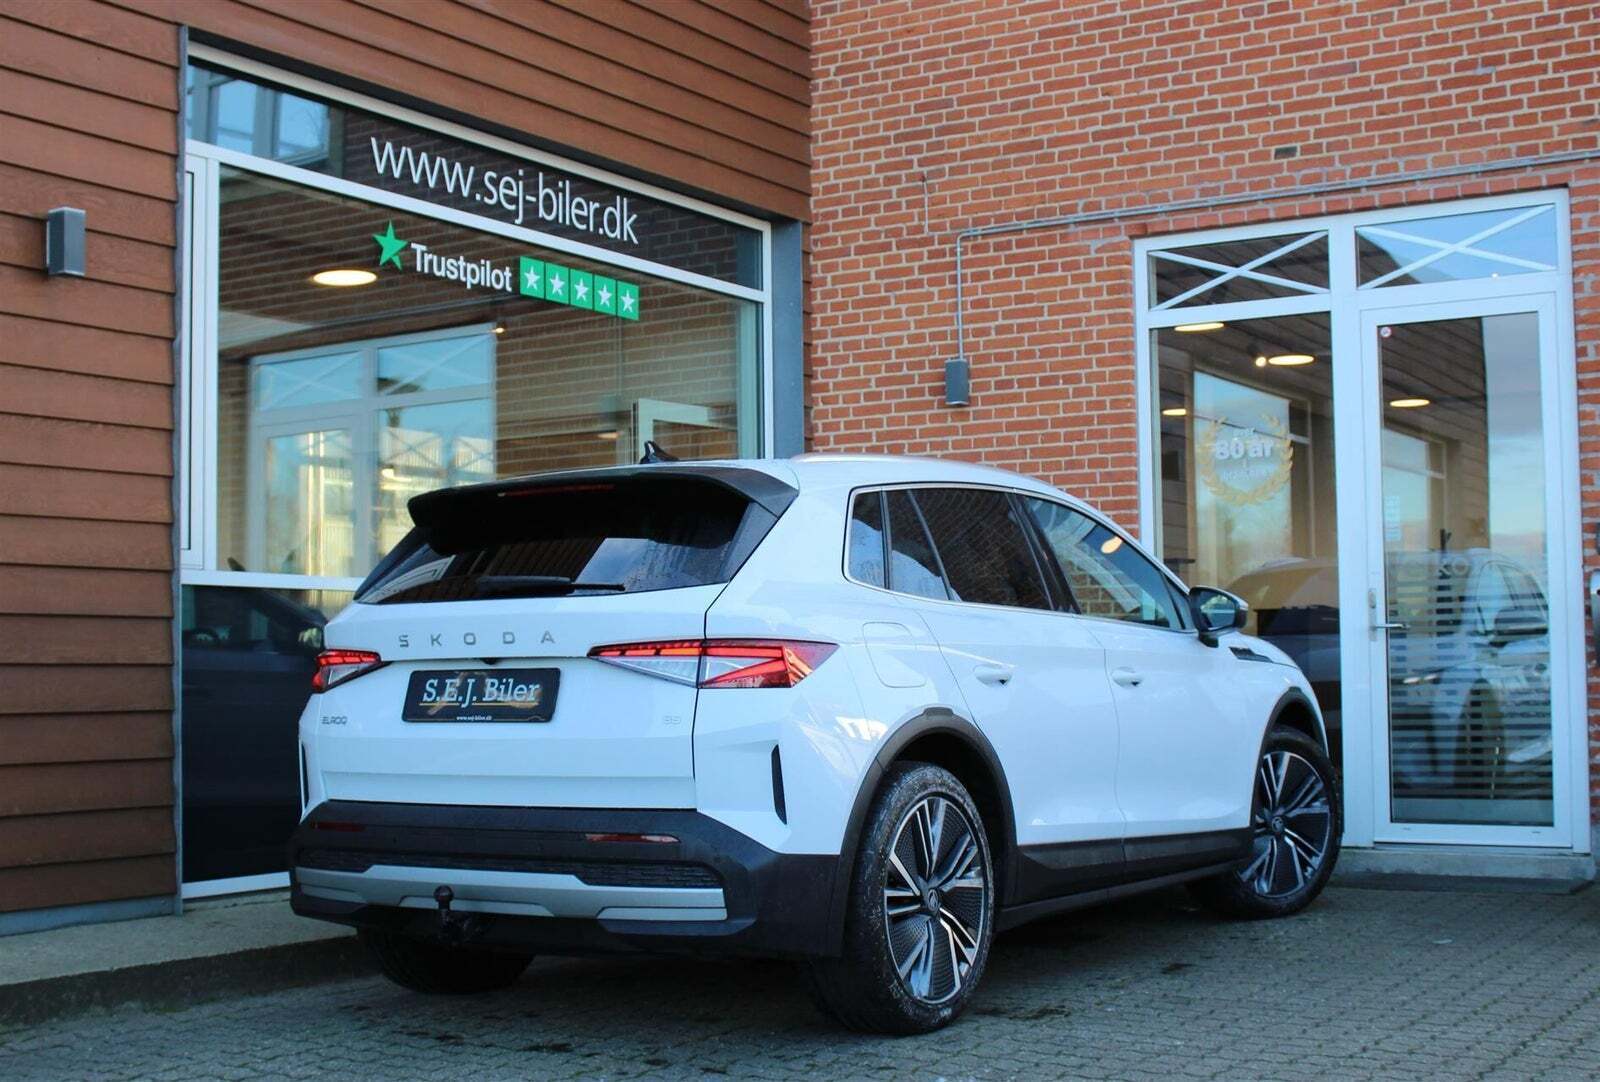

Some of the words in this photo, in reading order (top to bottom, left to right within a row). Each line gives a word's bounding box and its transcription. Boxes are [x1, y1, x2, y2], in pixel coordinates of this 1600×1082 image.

[370, 136, 639, 245] www.sej-biler.dk
[410, 242, 513, 293] Trustpilot
[422, 678, 477, 708] S.E.J.
[482, 677, 541, 702] Biler
